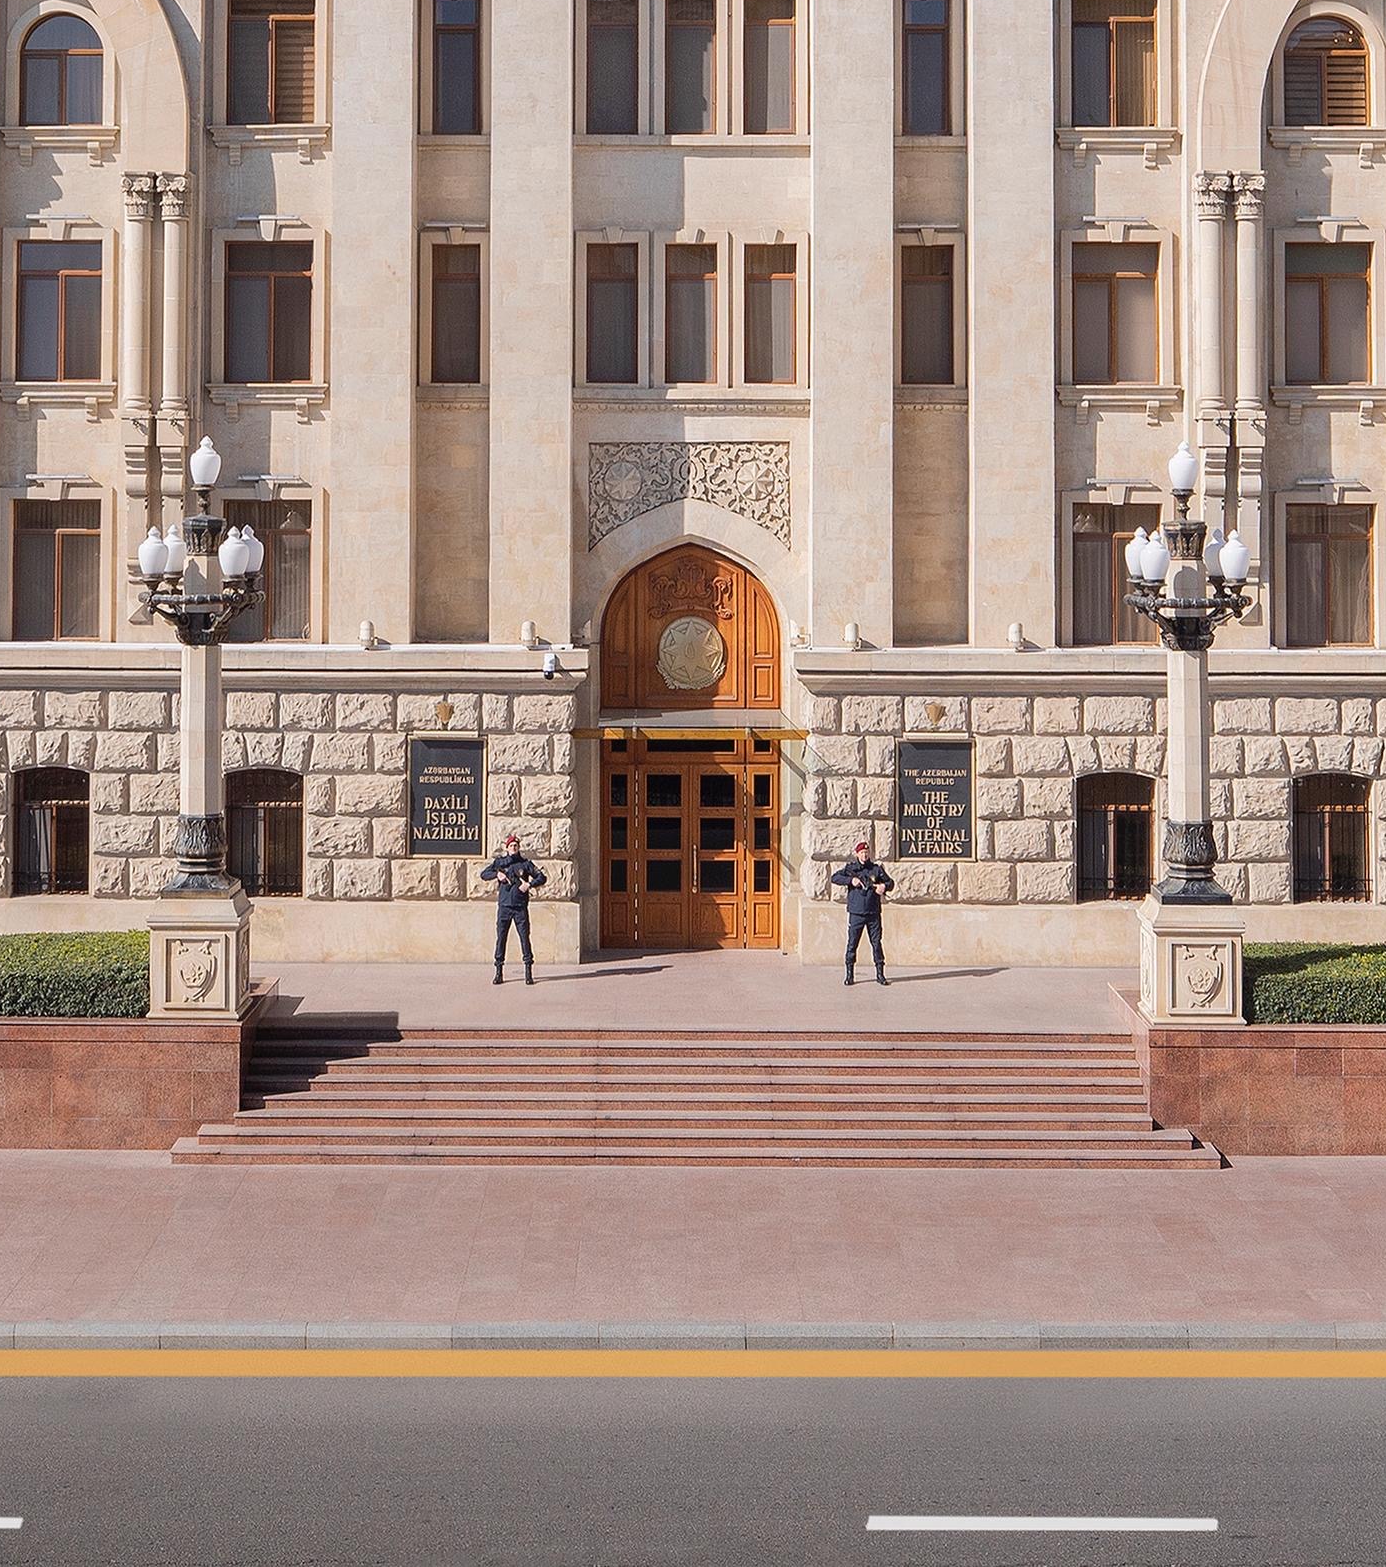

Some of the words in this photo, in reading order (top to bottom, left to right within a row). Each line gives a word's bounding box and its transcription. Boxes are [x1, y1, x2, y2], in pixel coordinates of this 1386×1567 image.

[904, 769, 919, 777] THE
[921, 769, 967, 777] AZERBAIJAN
[915, 777, 955, 786] REPUBLIC
[424, 794, 469, 810] DAXİLİ
[922, 791, 949, 804] THE
[903, 804, 965, 817] MINISTRY
[425, 809, 466, 827] İŞLƏR
[926, 816, 944, 829] OF
[413, 824, 479, 841] NAZİRLİYİ
[901, 829, 970, 842] INTERNAL
[908, 841, 963, 854] AFFAIRS
